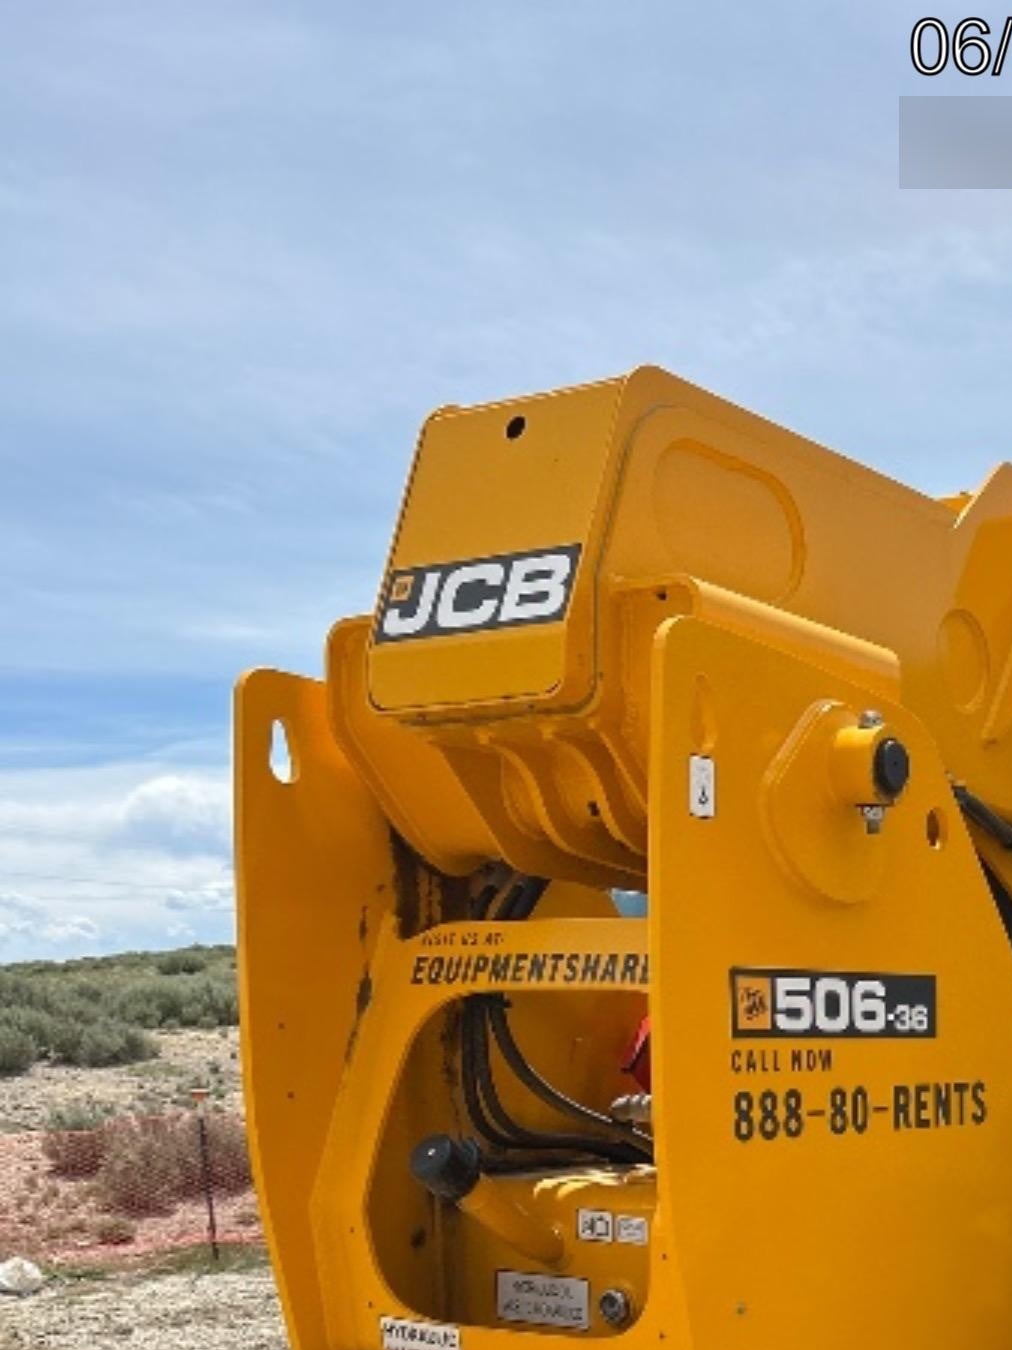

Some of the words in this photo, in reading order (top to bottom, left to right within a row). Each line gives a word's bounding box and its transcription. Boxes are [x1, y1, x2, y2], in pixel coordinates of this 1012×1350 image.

[383, 554, 571, 636] JCB
[730, 1049, 781, 1073] CALL
[790, 1049, 833, 1072] NOW
[734, 1079, 987, 1141] 888-80-RENTS
